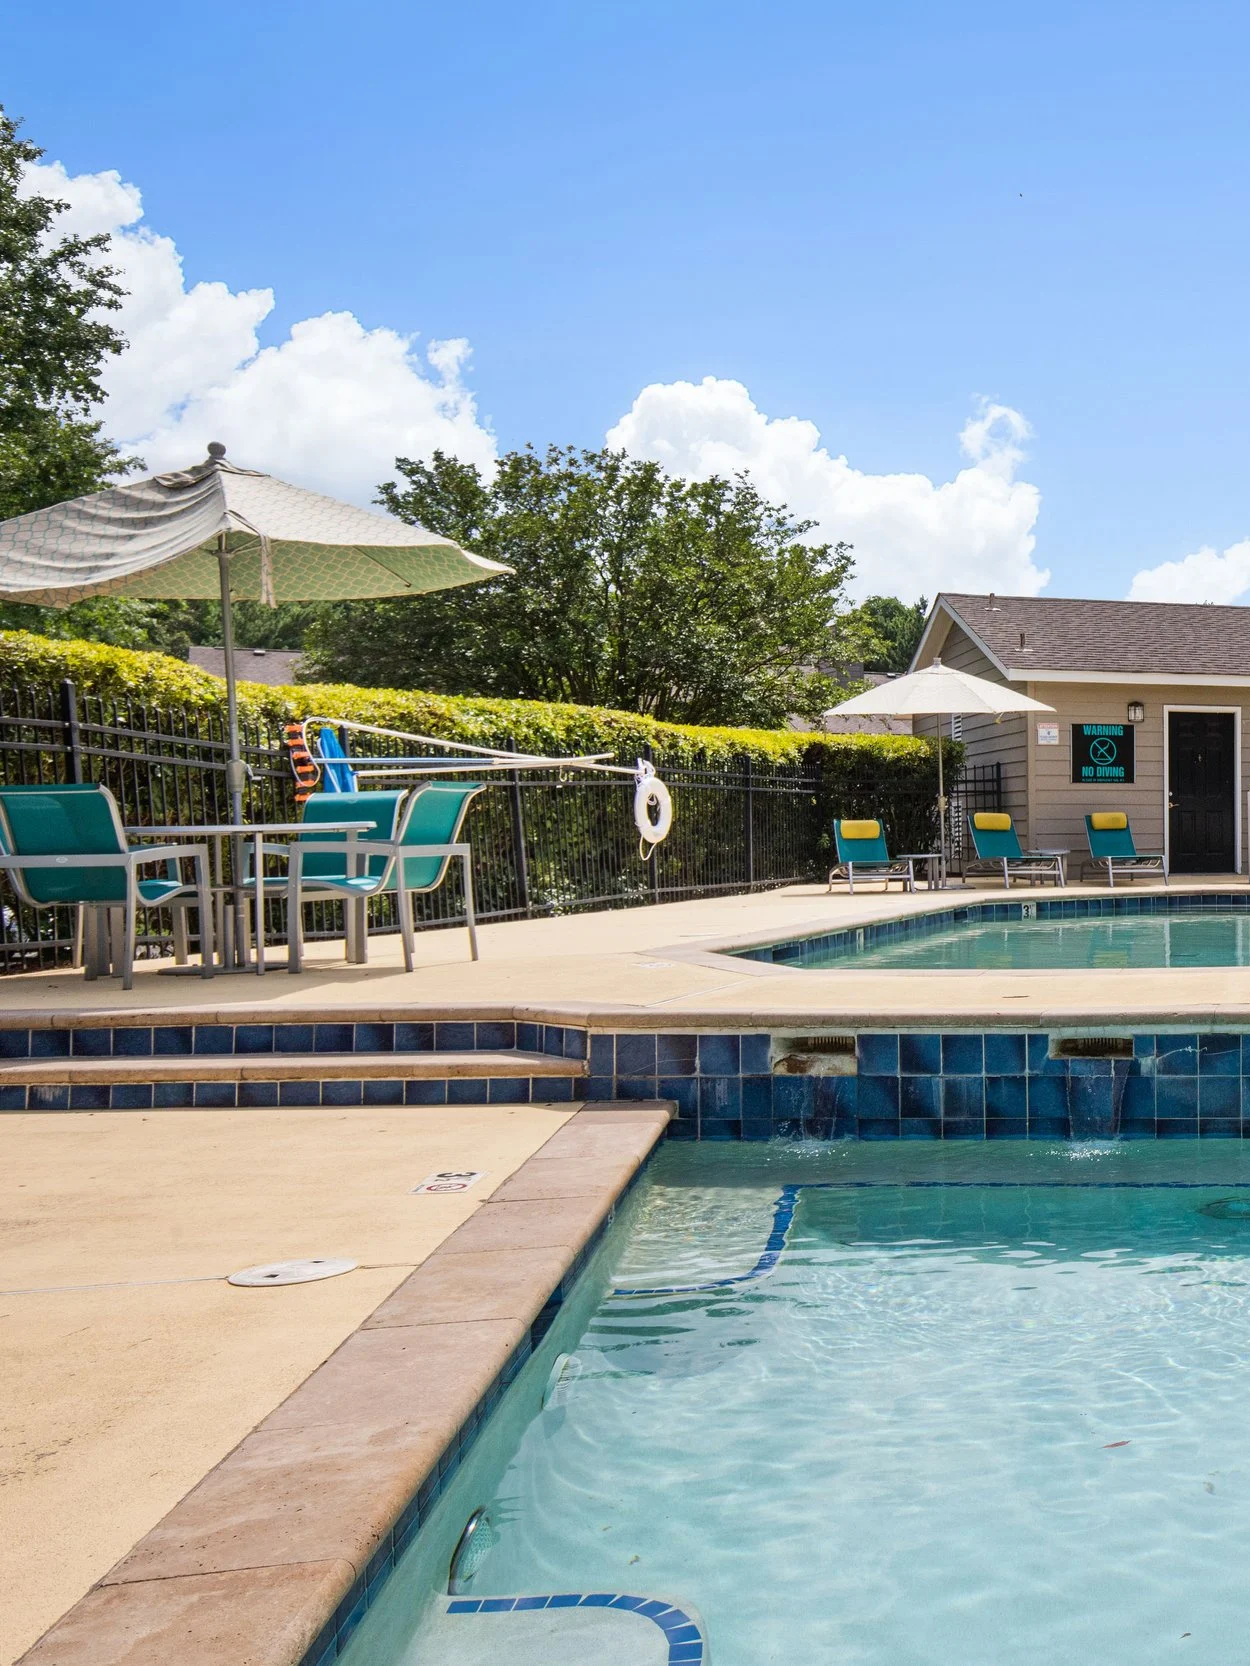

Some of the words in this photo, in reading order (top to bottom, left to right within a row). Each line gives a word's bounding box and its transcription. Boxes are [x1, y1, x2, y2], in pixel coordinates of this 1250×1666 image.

[1083, 725, 1124, 736] WARNING
[1082, 766, 1094, 777] NO
[1096, 766, 1125, 777] DIVING
